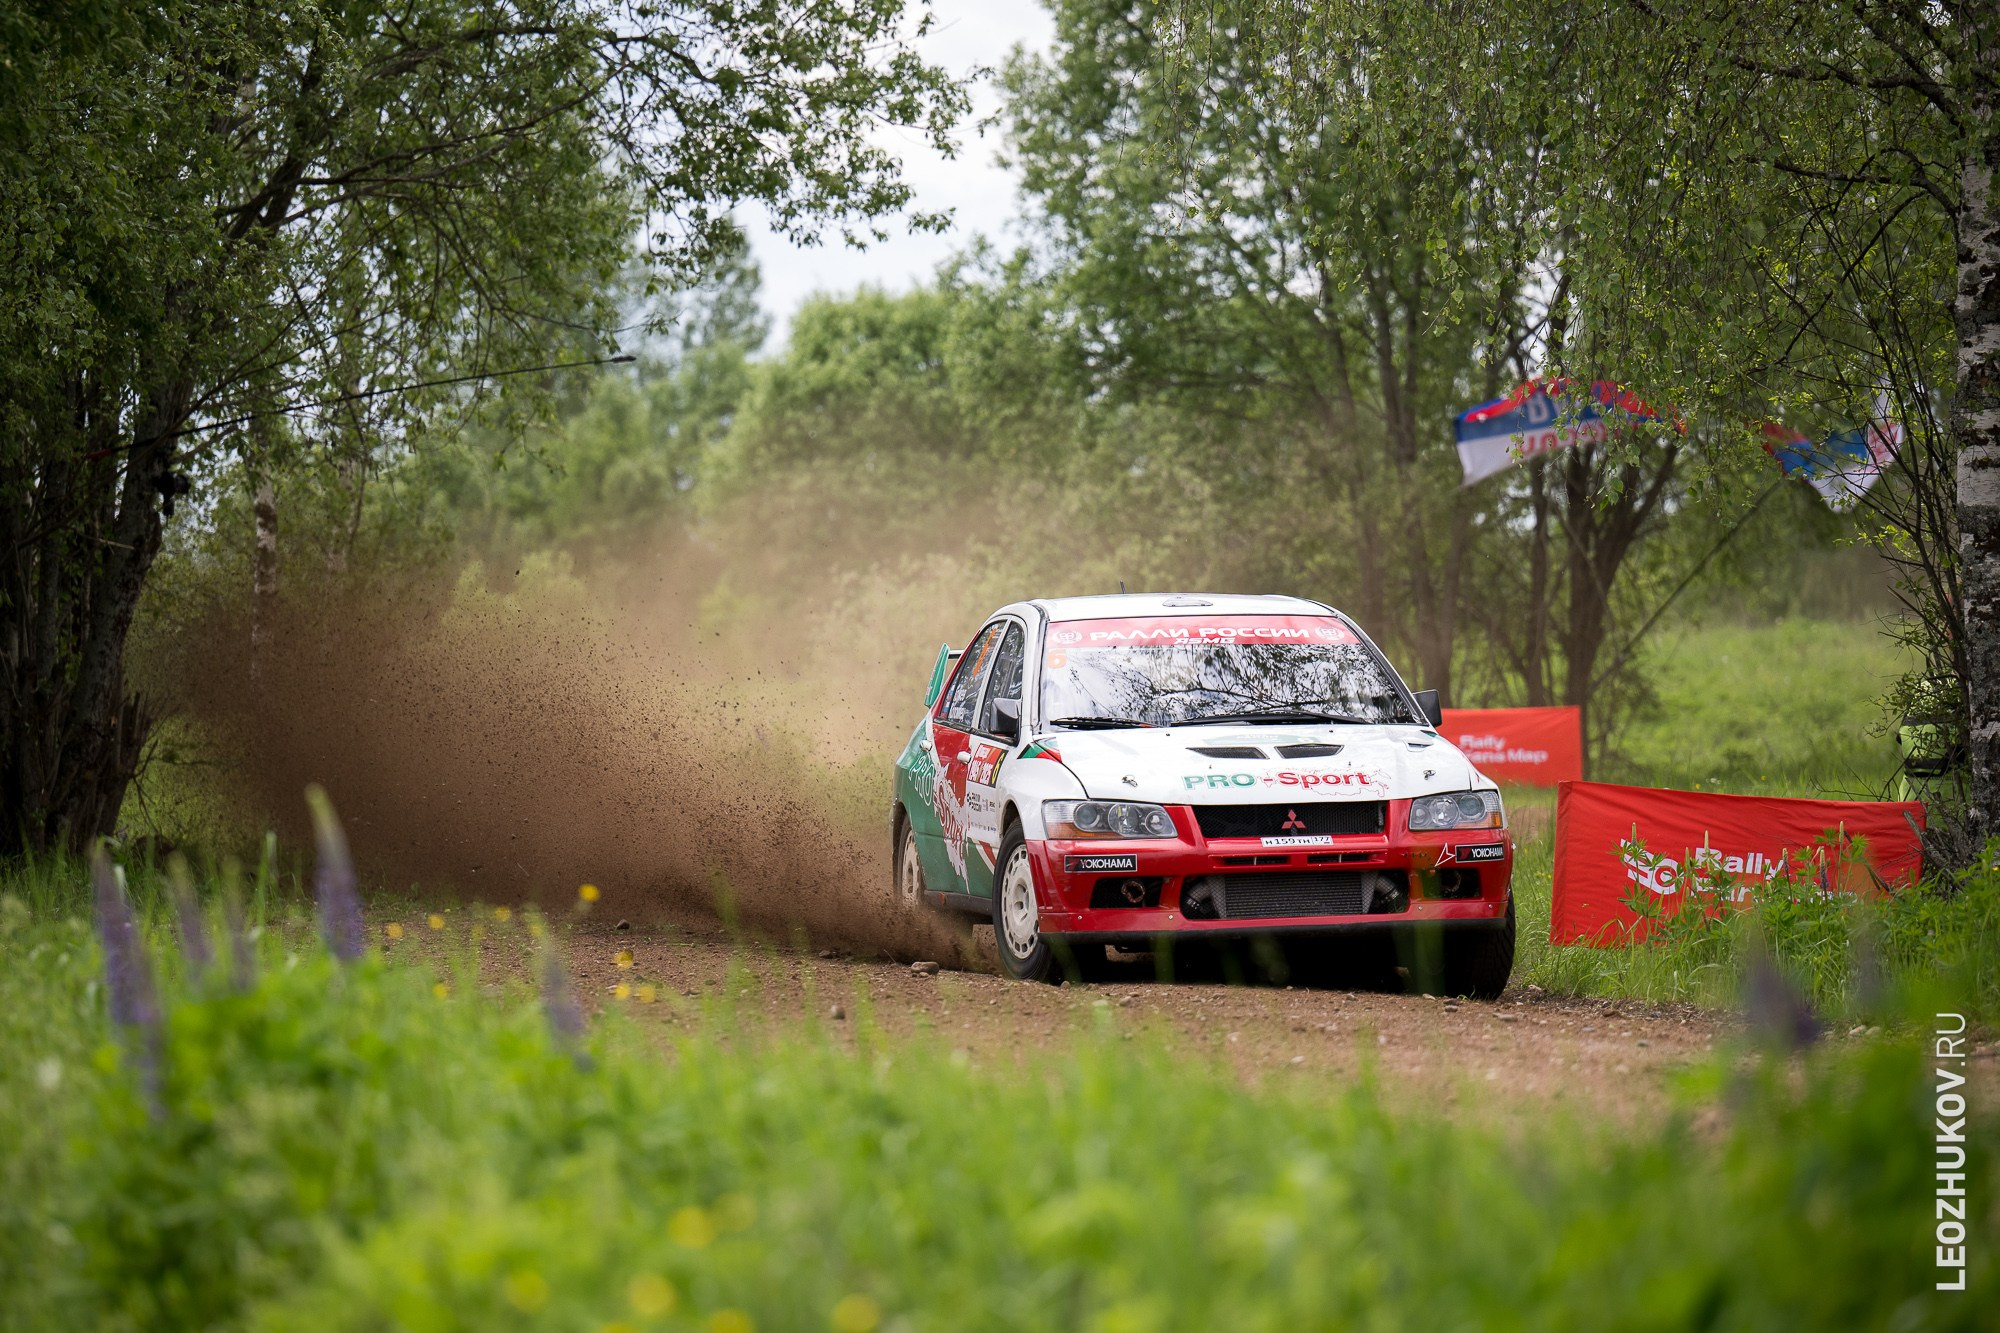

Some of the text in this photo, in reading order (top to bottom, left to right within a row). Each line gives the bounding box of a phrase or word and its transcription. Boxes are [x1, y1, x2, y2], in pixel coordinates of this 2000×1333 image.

[1089, 628, 1190, 640] РАЛЛИ
[1199, 628, 1309, 638] РОССИИ
[1047, 648, 1067, 669] 6
[1460, 734, 1506, 749] Rally
[1471, 847, 1504, 858] YOKOHAMA
[1080, 858, 1133, 869] YOKOHAMA
[1695, 847, 1785, 880] Rally
